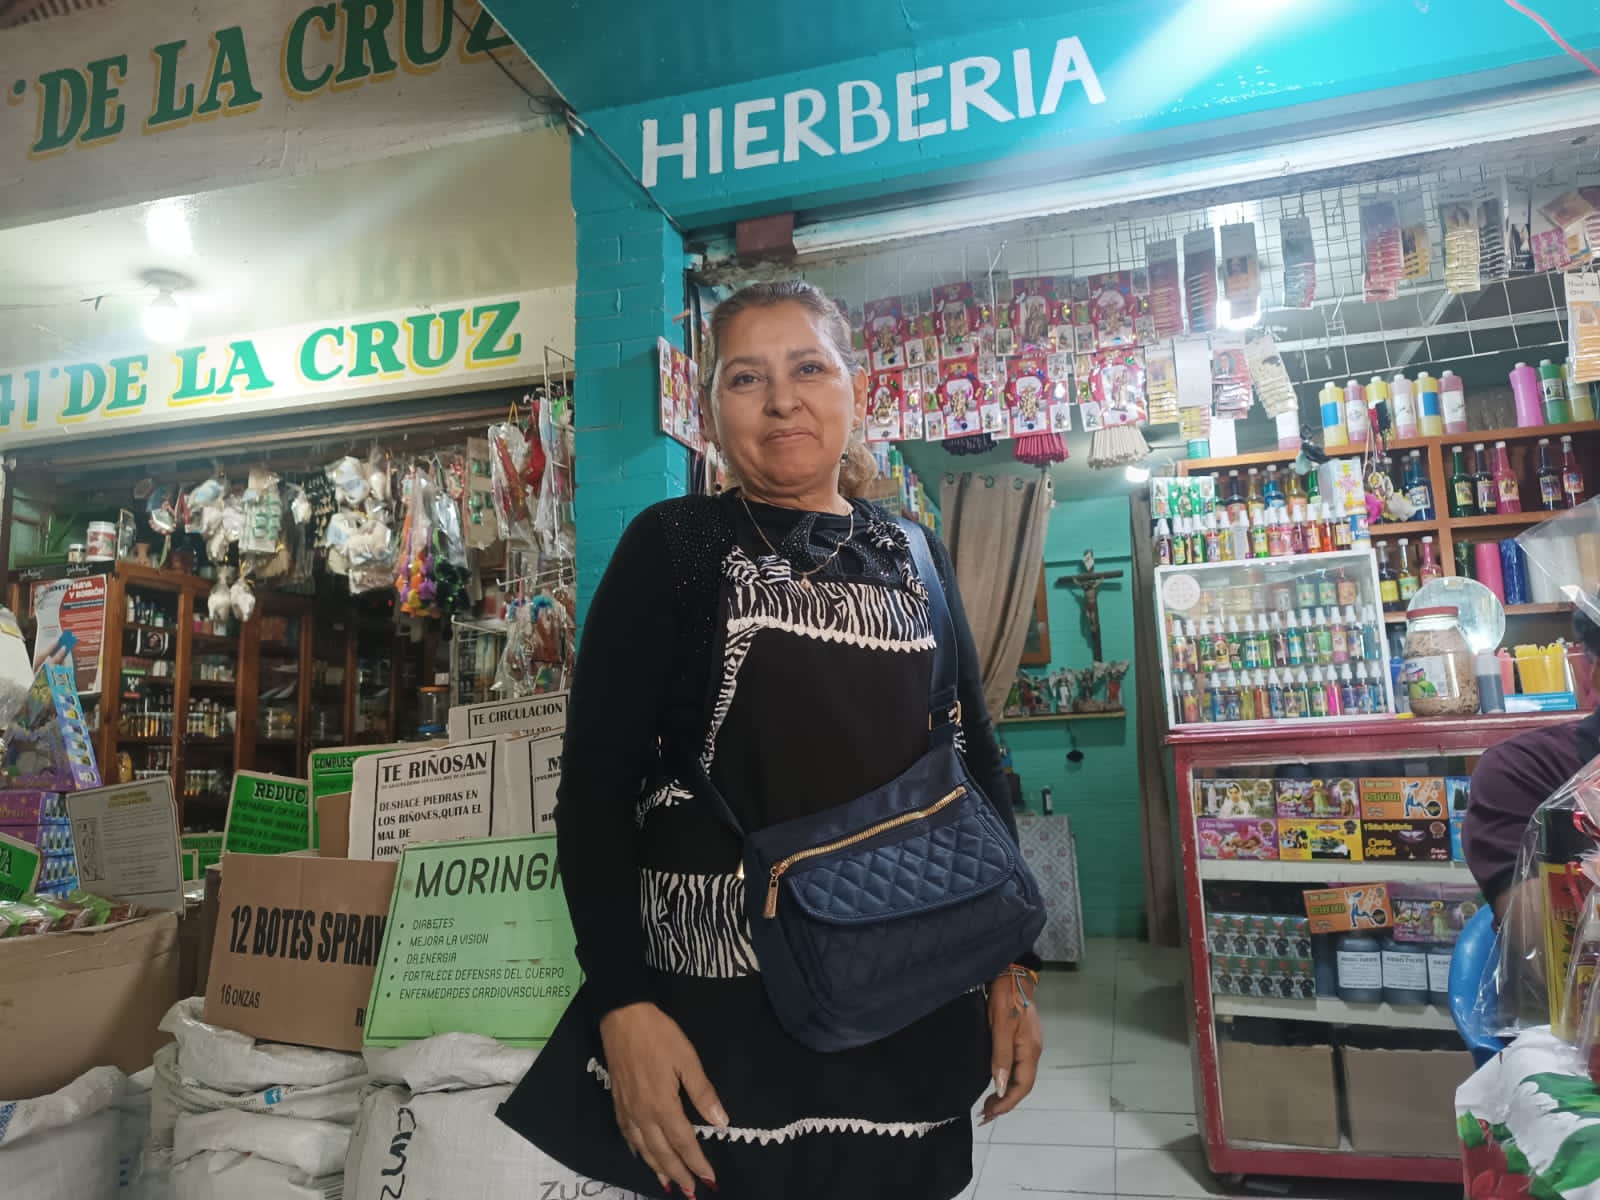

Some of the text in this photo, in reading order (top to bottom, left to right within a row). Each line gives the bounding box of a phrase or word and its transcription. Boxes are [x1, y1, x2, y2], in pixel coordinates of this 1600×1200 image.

[31, 53, 128, 154] DE
[146, 25, 263, 127] LA
[641, 35, 1106, 188] HIERBERIA
[61, 354, 148, 417] DE
[171, 339, 275, 401] LA
[300, 300, 522, 383] CRUZ
[472, 702, 563, 726] TE CIRCULACION
[381, 764, 402, 783] TE
[408, 751, 487, 779] RIÑOSAN
[253, 781, 309, 806] REDUC
[379, 789, 479, 812] DESHACE PIEDRAS EN
[377, 815, 396, 827] LOS
[471, 804, 482, 814] EL
[377, 828, 411, 841] MAL DE
[229, 904, 252, 954] 12
[251, 906, 316, 961] BOTES
[412, 917, 455, 930] DIABETES
[410, 932, 489, 947] MEJORA LA VISION
[402, 966, 565, 982] FORTALECE DEFENSAS DEL CUERPO
[219, 983, 261, 1009] 16 ONZAS
[399, 985, 572, 1000] ENFERMEDADES CARDIOVASCULARES
